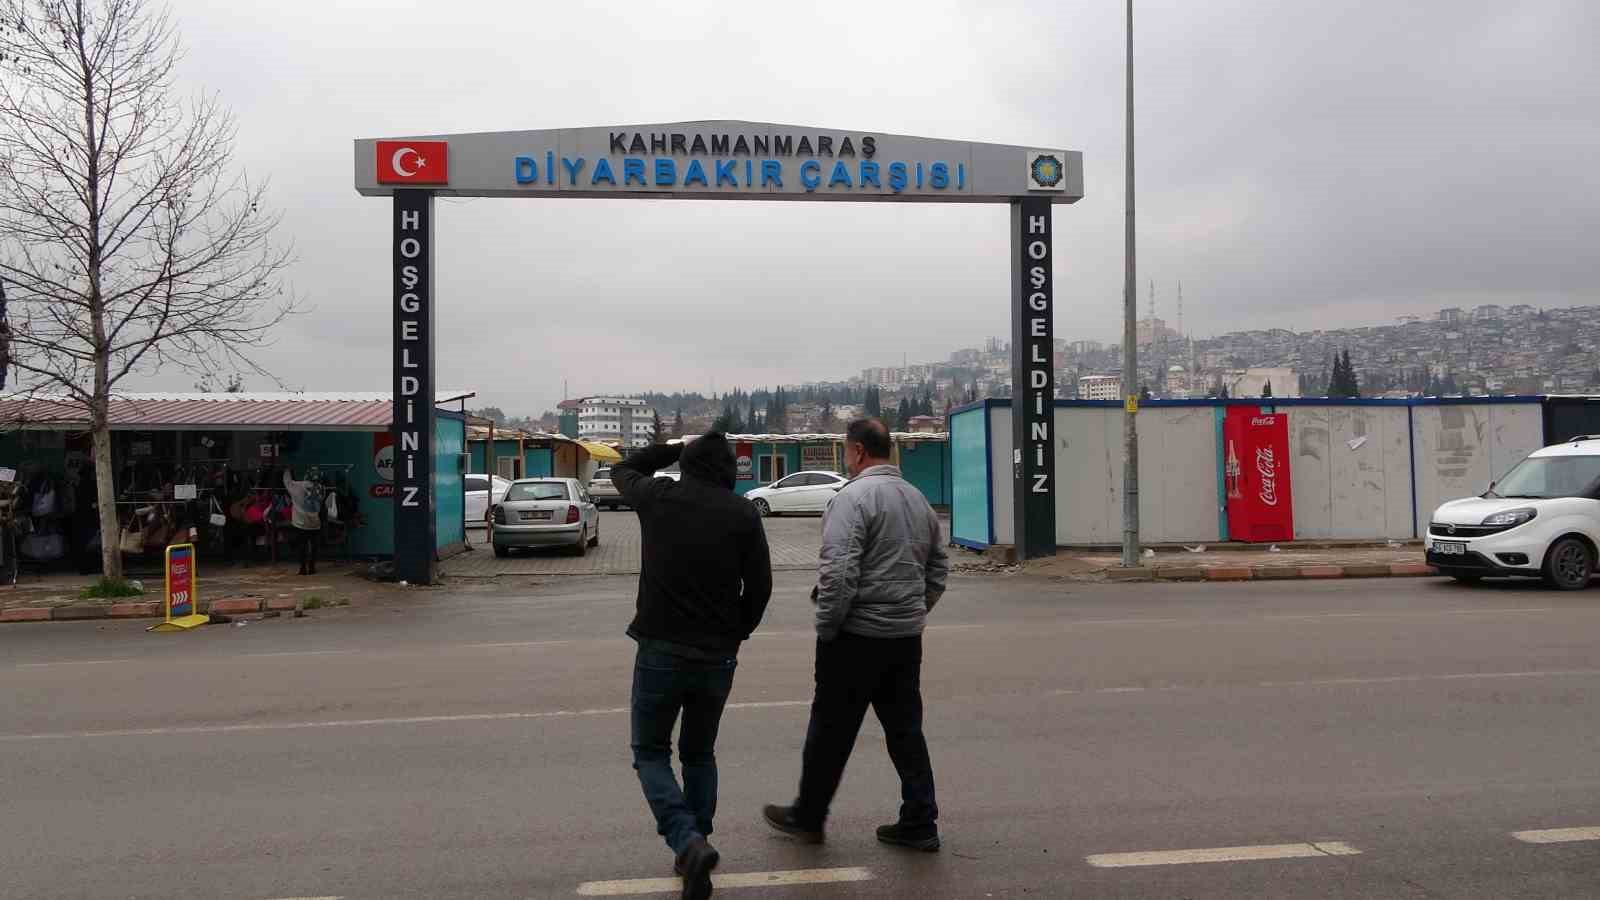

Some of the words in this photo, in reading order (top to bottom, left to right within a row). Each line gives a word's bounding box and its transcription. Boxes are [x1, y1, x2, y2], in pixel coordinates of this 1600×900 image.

[608, 132, 877, 158] KAHRAMANMARAŞ
[514, 151, 783, 189] DİYARBAKIR
[800, 159, 966, 194] ÇARŞISI
[1256, 446, 1278, 506] Coca-Cola
